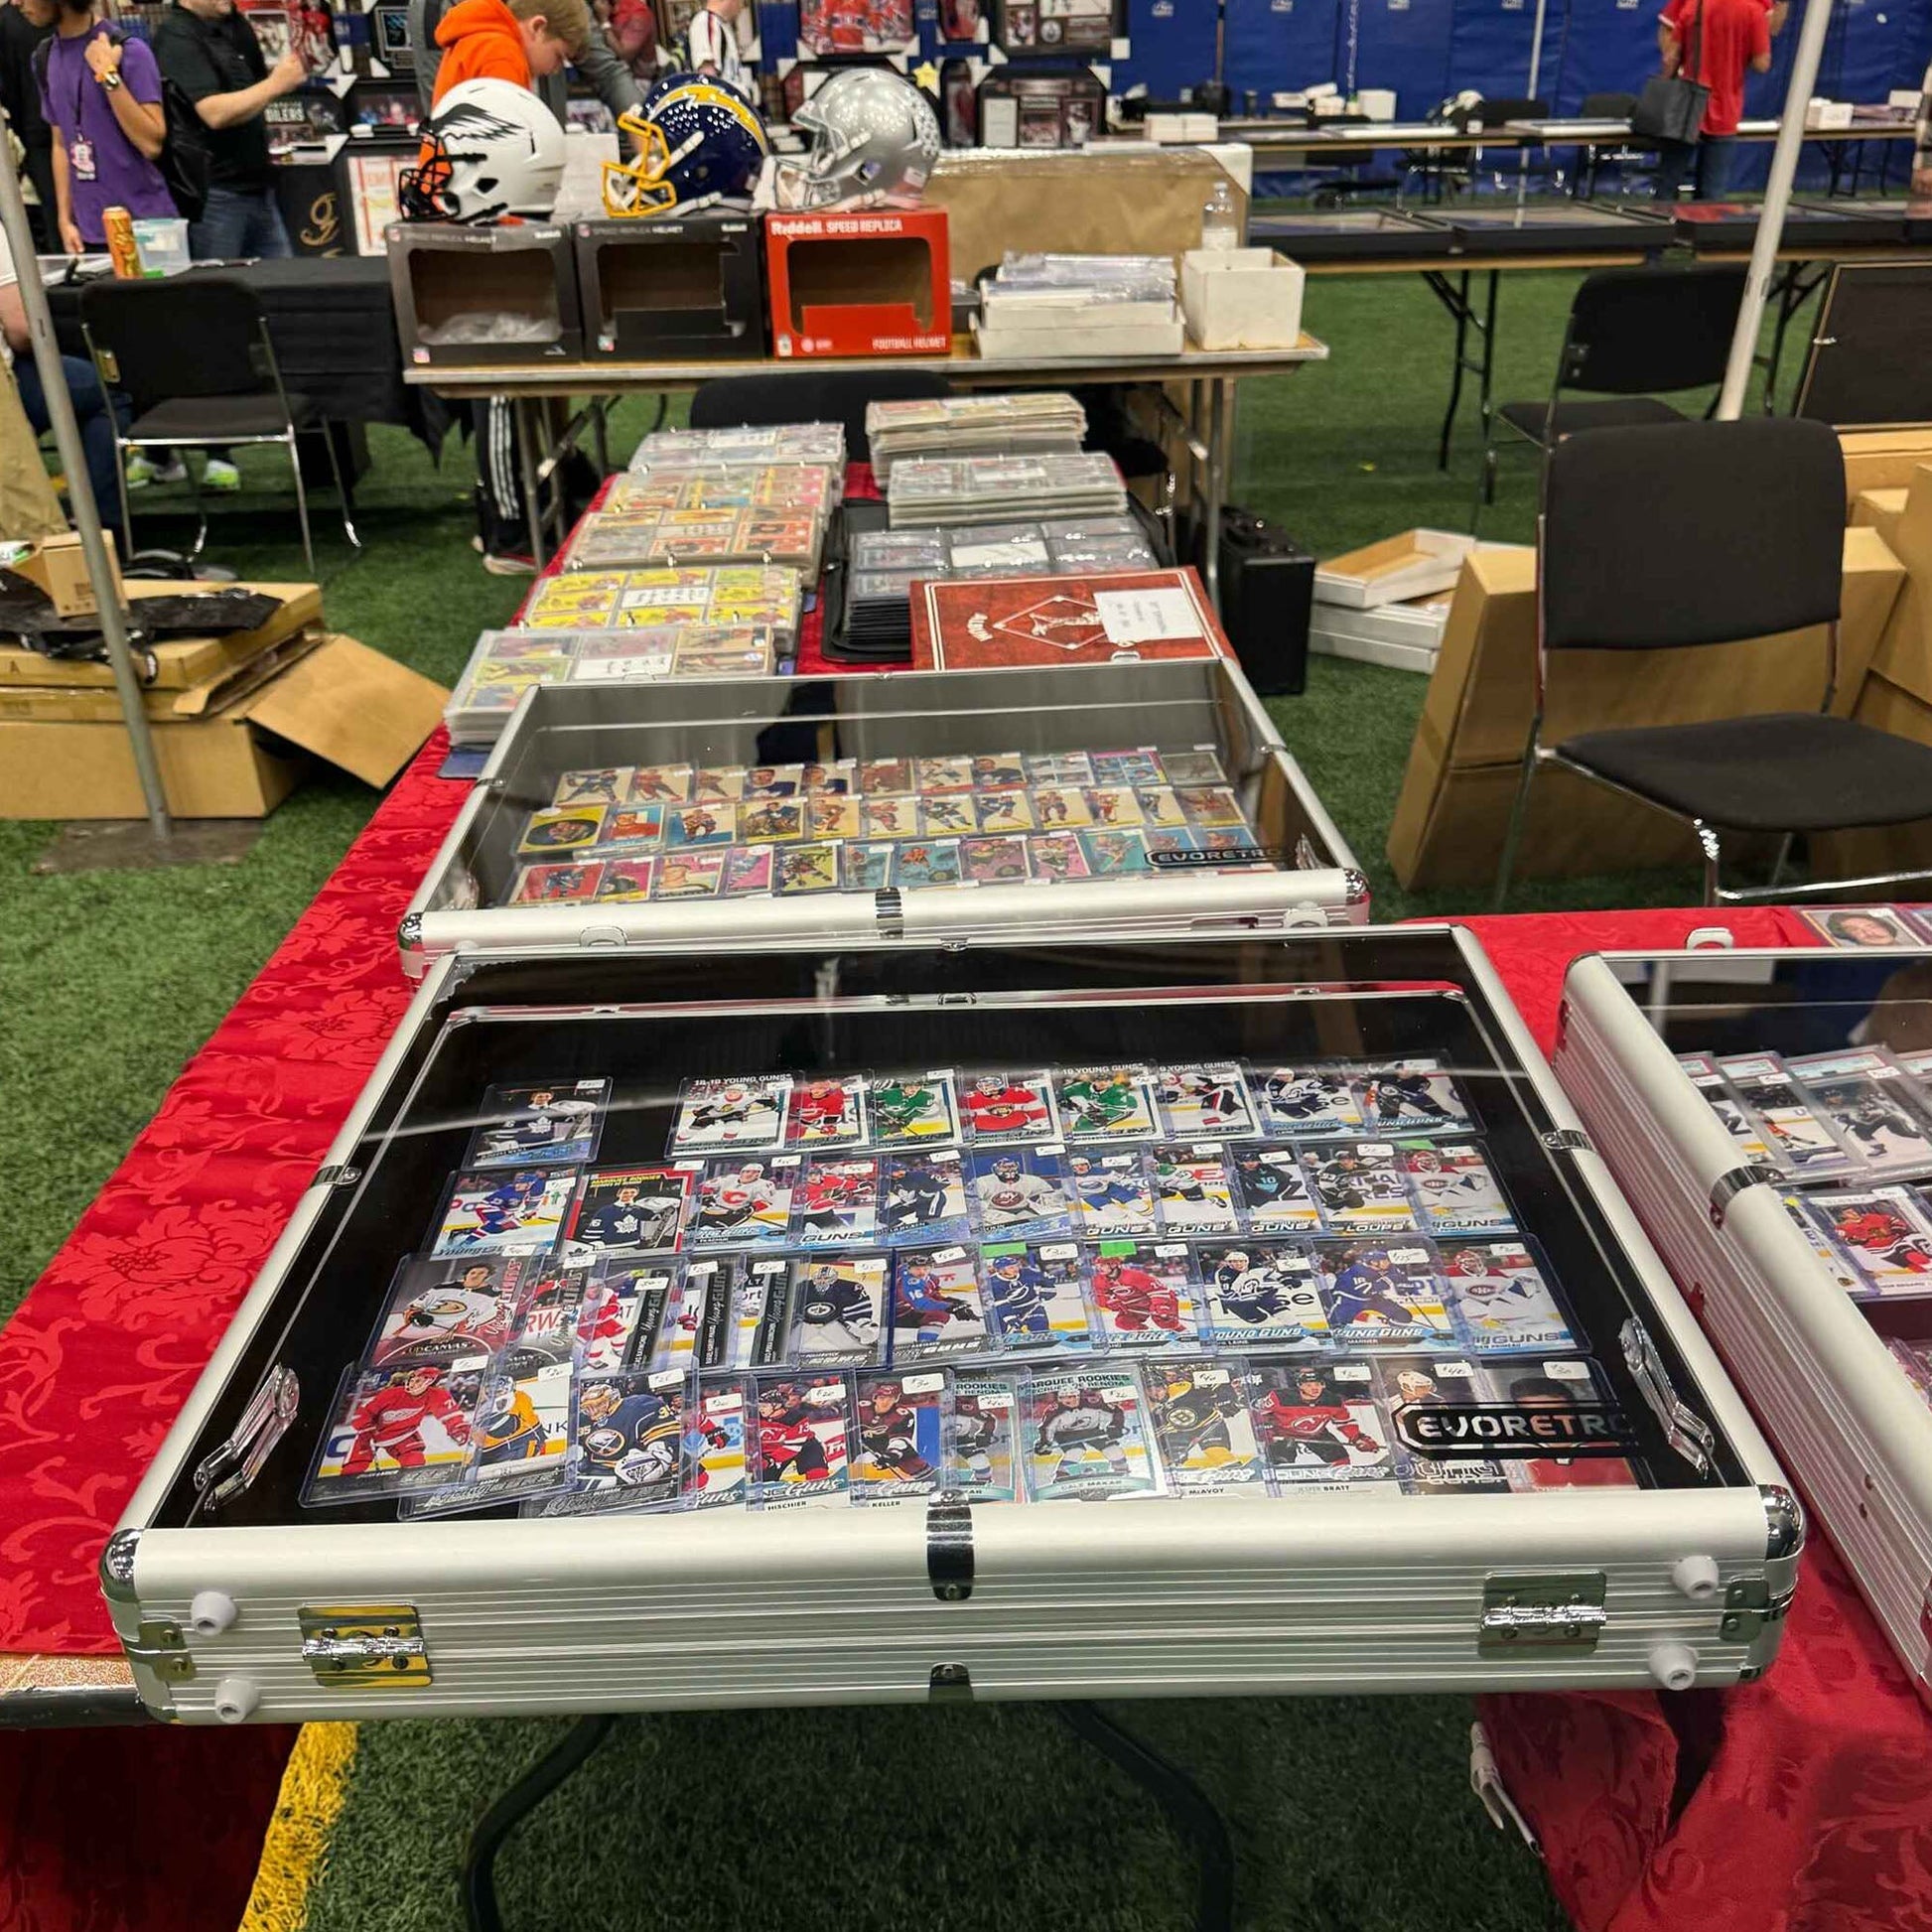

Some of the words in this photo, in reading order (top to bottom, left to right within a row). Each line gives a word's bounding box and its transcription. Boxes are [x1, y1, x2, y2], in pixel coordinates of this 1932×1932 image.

[770, 219, 823, 236] Riddell
[826, 219, 859, 233] SPEED
[860, 217, 903, 232] REPLICA
[1075, 1065, 1110, 1074] YOUNG
[1168, 1063, 1203, 1072] YOUNG
[1203, 1060, 1236, 1069] GUNS
[723, 1075, 757, 1085] YOUNG
[759, 1073, 792, 1082] GUNS
[1258, 1327, 1304, 1337] GUNS
[1381, 1327, 1424, 1337] GUNS
[1491, 1331, 1559, 1344] GUNS
[1077, 1373, 1131, 1383] ROOKIES
